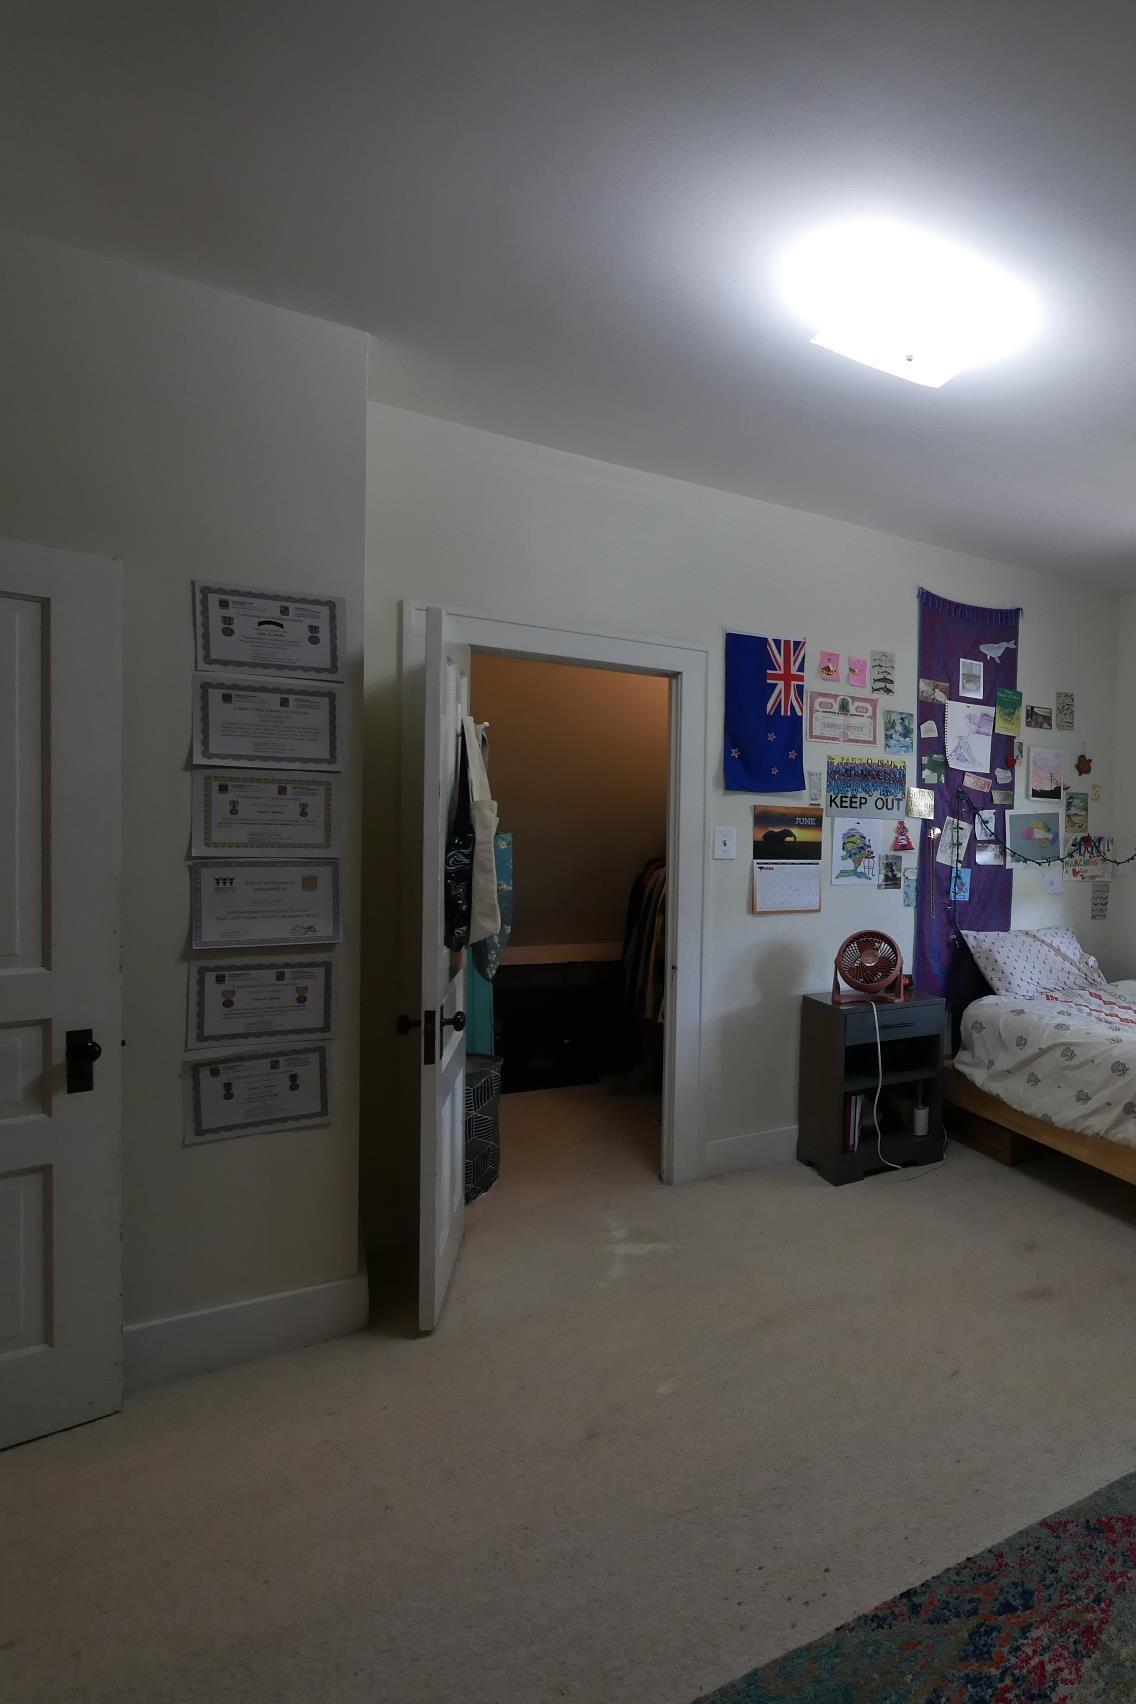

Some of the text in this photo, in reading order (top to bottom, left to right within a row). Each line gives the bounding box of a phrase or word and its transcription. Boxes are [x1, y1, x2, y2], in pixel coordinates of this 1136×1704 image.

[830, 795, 903, 811] KEEP OUT
[795, 817, 816, 825] JUNE
